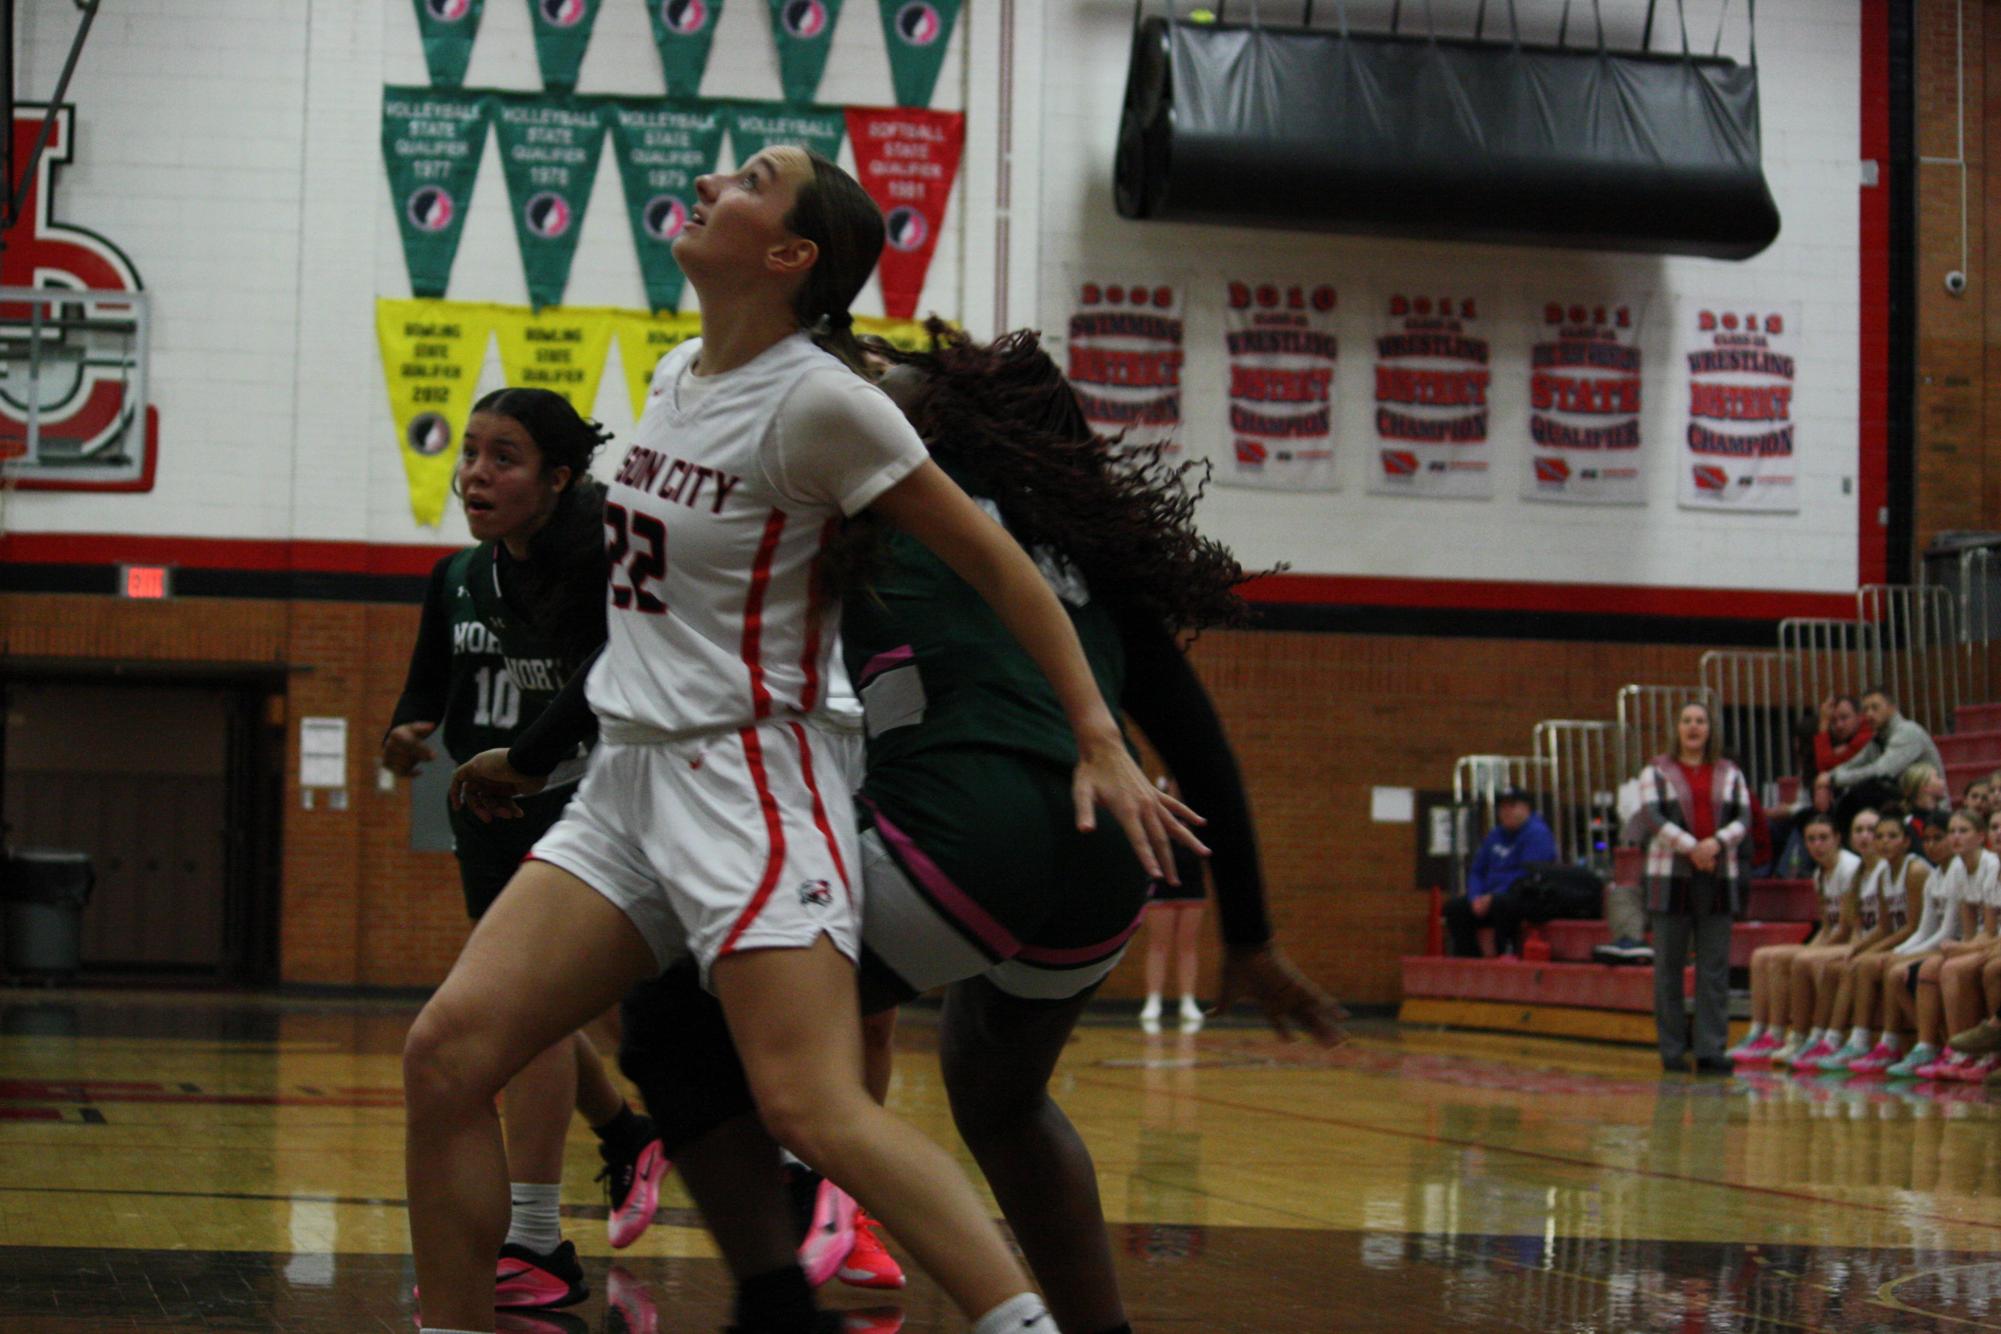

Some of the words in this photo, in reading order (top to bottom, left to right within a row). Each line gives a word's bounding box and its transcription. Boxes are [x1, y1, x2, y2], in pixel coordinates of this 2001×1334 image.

[386, 101, 482, 121] VOLLEYBALL
[502, 107, 599, 128] VOLLEYBALL
[617, 111, 715, 131] VOLLEYBALL
[408, 120, 456, 137] STATE
[526, 127, 573, 144] STATE
[737, 115, 836, 137] VOLLEYBALL
[868, 121, 946, 142] SOFTBALL
[395, 140, 469, 156] QUALIFIER
[644, 130, 691, 147] STATE
[511, 145, 587, 163] QUALIFIER
[631, 149, 704, 166] QUALIFIER
[882, 141, 931, 159] STATE
[413, 160, 451, 179] 1977
[869, 160, 944, 179] QUALIFIER
[404, 323, 461, 340] BOWLING
[525, 327, 584, 343] BOWLING
[413, 343, 449, 359] STATE
[535, 347, 572, 364] STATE
[1687, 349, 1794, 380] WRESTLING
[1530, 373, 1643, 415] STATE
[1689, 381, 1793, 421] DISTRICT
[1375, 406, 1489, 443] CHAMPION
[1530, 414, 1641, 450] QUALIFIER
[1687, 422, 1795, 459] CHAMPION
[658, 457, 743, 514] CITY
[604, 499, 669, 616] 22
[472, 665, 522, 730] 10
